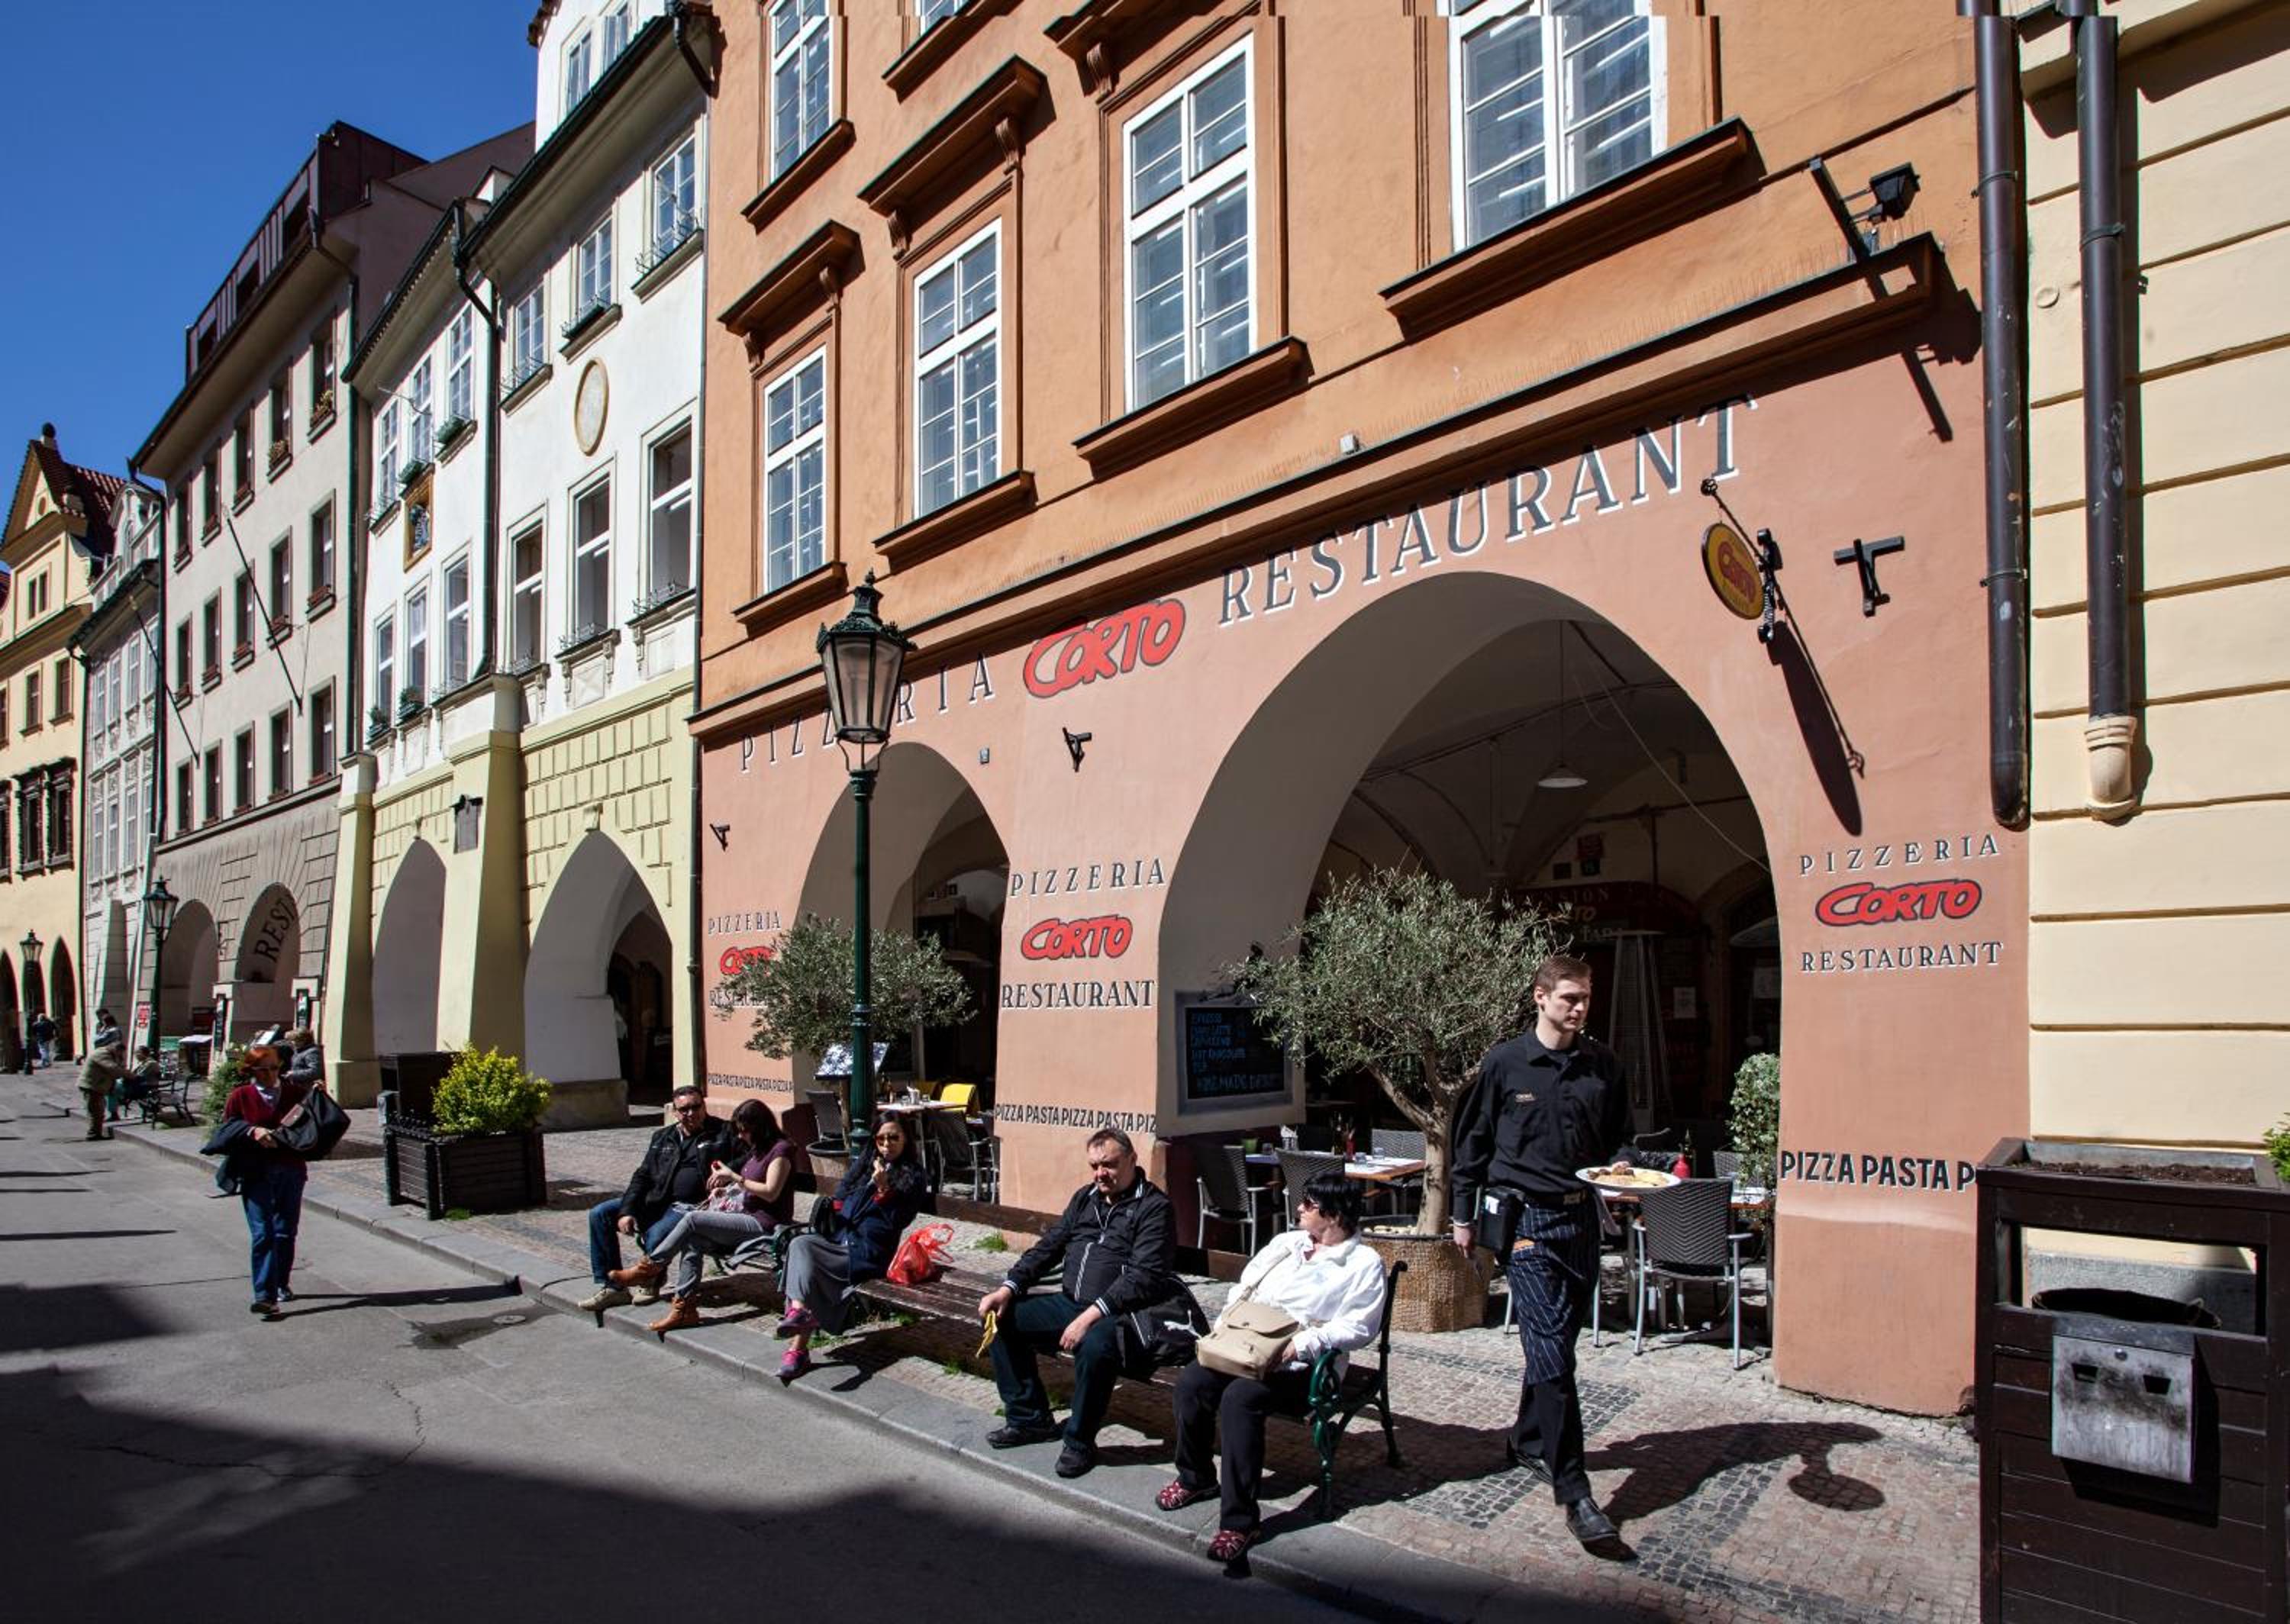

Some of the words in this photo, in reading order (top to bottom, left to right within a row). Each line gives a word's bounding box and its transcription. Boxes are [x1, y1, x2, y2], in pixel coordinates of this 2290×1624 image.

[740, 651, 994, 773] PIZZRIA
[1022, 598, 1185, 698] CORTO
[1218, 392, 1759, 627] RESTAURANT
[1799, 833, 2001, 878] PIZZERIA
[1009, 858, 1166, 897] PIZZERIA
[1815, 878, 1982, 927] CORTO
[708, 910, 782, 936] PIZZERIA
[1021, 914, 1134, 961] CORTO
[1801, 941, 2003, 972] RESTAURANT
[1001, 979, 1156, 1010] RESTAURANT
[995, 1104, 1024, 1123] PIZZA
[1026, 1104, 1060, 1126] PASTA
[1062, 1107, 1094, 1129] PIZZA
[1096, 1110, 1134, 1132] PASTA
[1780, 1150, 1855, 1184] PIZZA
[1861, 1155, 1951, 1191] PASTA
